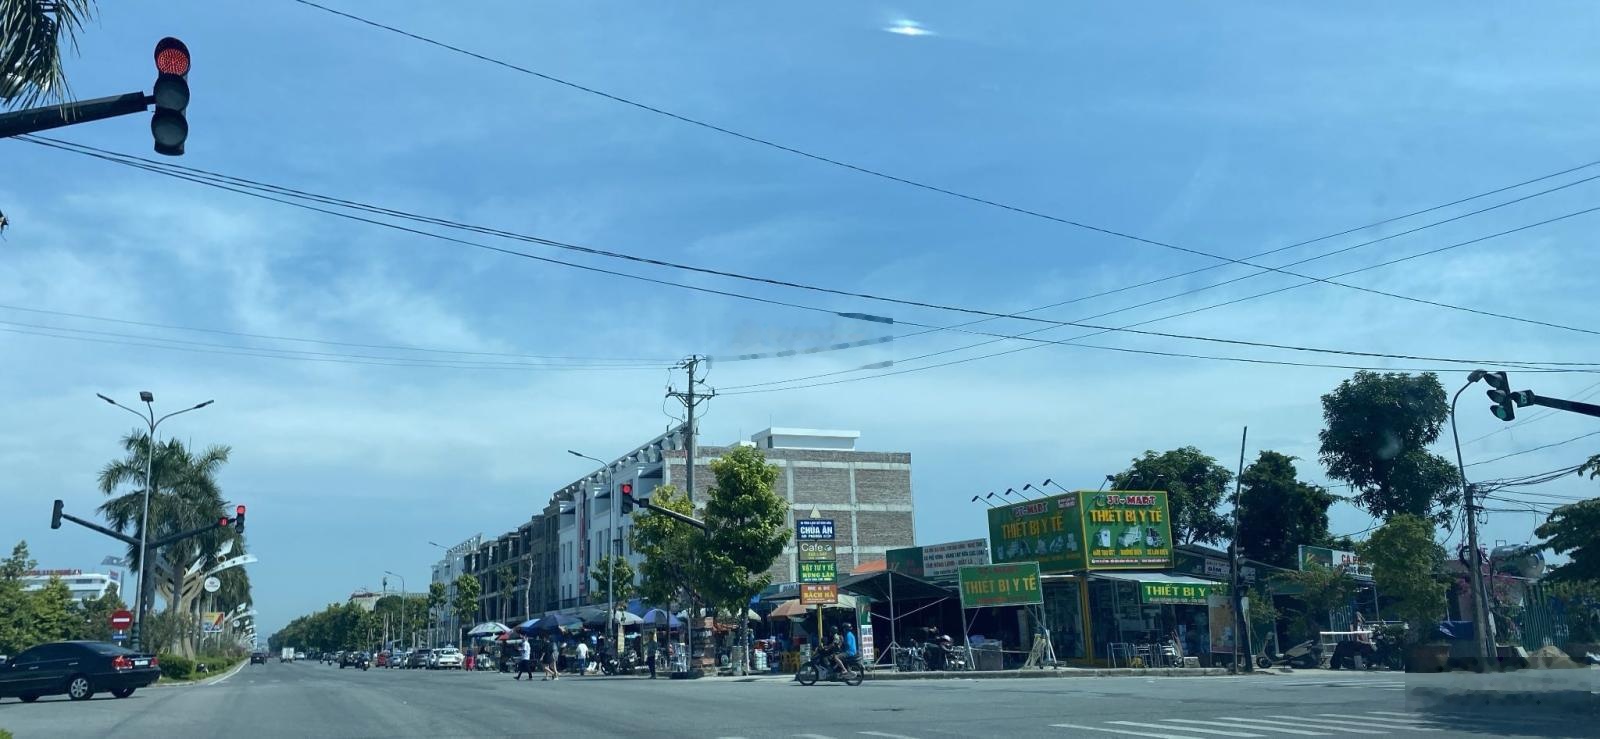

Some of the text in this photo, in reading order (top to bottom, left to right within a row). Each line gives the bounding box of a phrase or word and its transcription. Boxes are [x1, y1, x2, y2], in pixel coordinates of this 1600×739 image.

[1090, 506, 1162, 525] THIẾT BỊ Y TẾ
[1001, 518, 1027, 539] THIẾT
[1041, 518, 1048, 534] Y
[801, 543, 823, 552] Cafe
[999, 579, 1010, 595] BỊ
[1013, 578, 1020, 592] Y
[1023, 573, 1037, 591] TẾ
[1145, 584, 1180, 596] THIẾT
[1183, 587, 1195, 599] BỊ
[1198, 588, 1206, 597] Y
